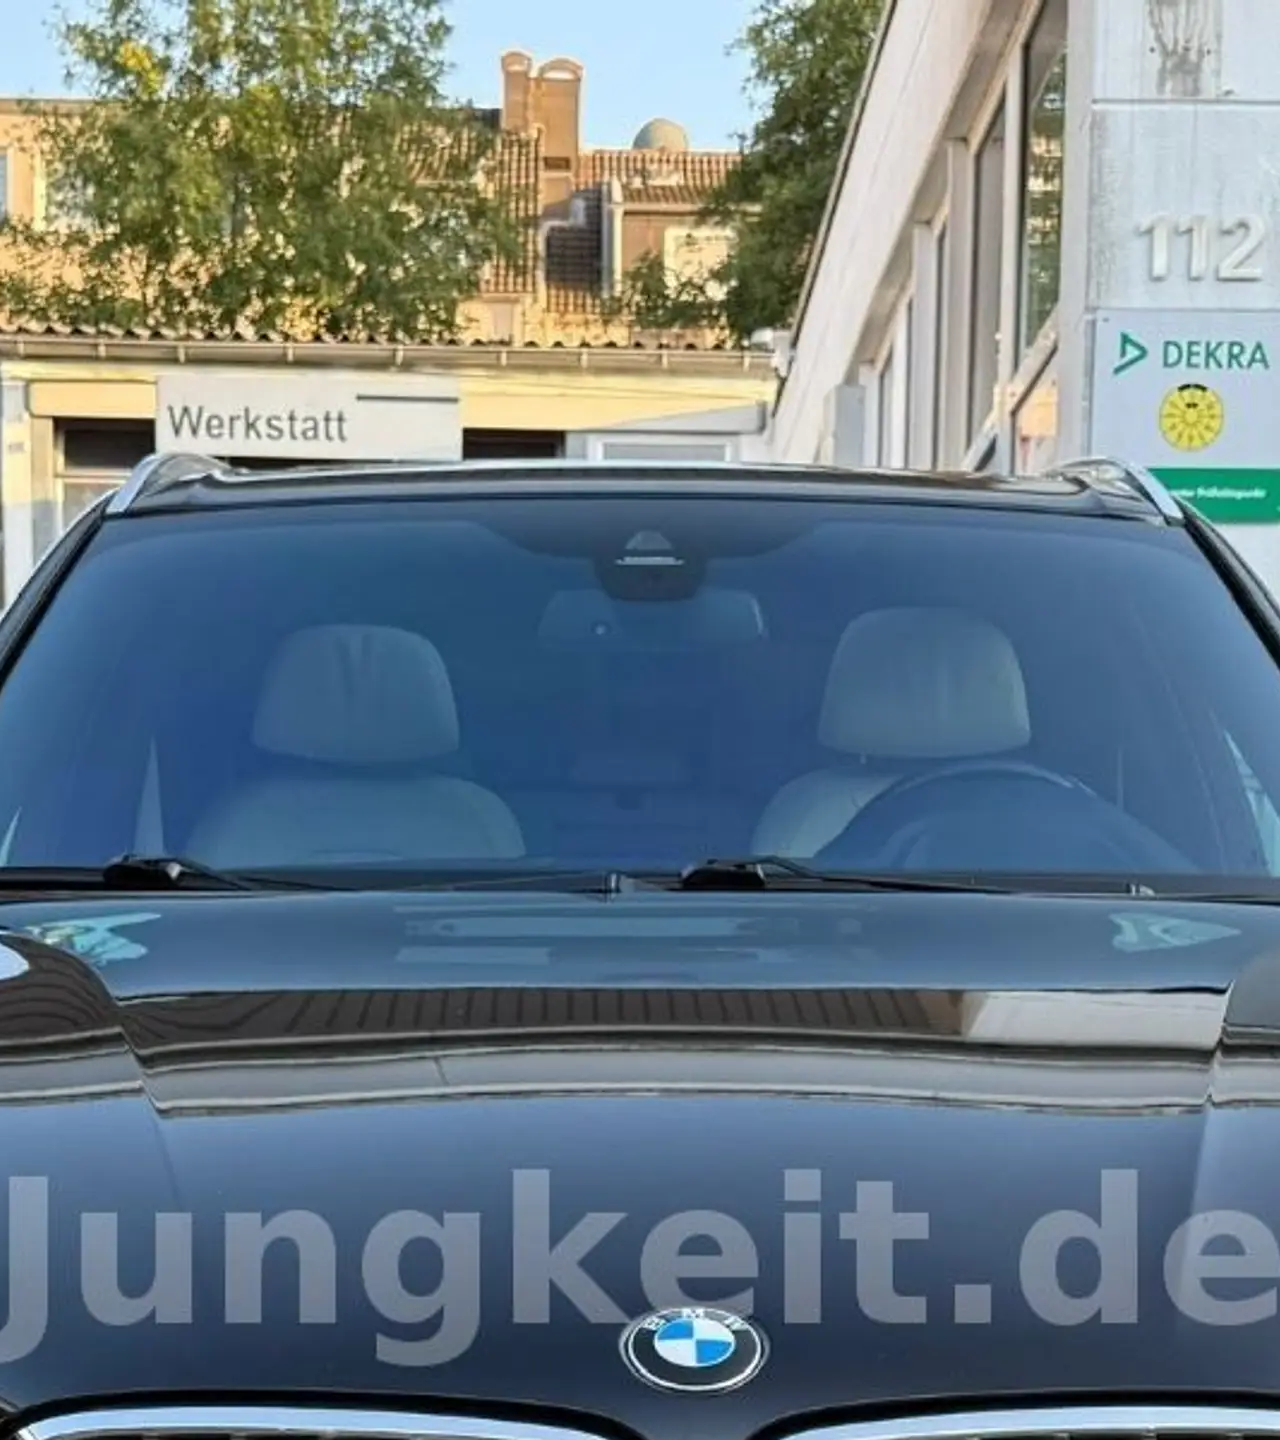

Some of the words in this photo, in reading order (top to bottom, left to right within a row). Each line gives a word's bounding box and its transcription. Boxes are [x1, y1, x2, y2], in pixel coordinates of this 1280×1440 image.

[1135, 212, 1266, 283] 112
[1162, 339, 1271, 369] DEKRA
[168, 404, 348, 442] Werkstatt
